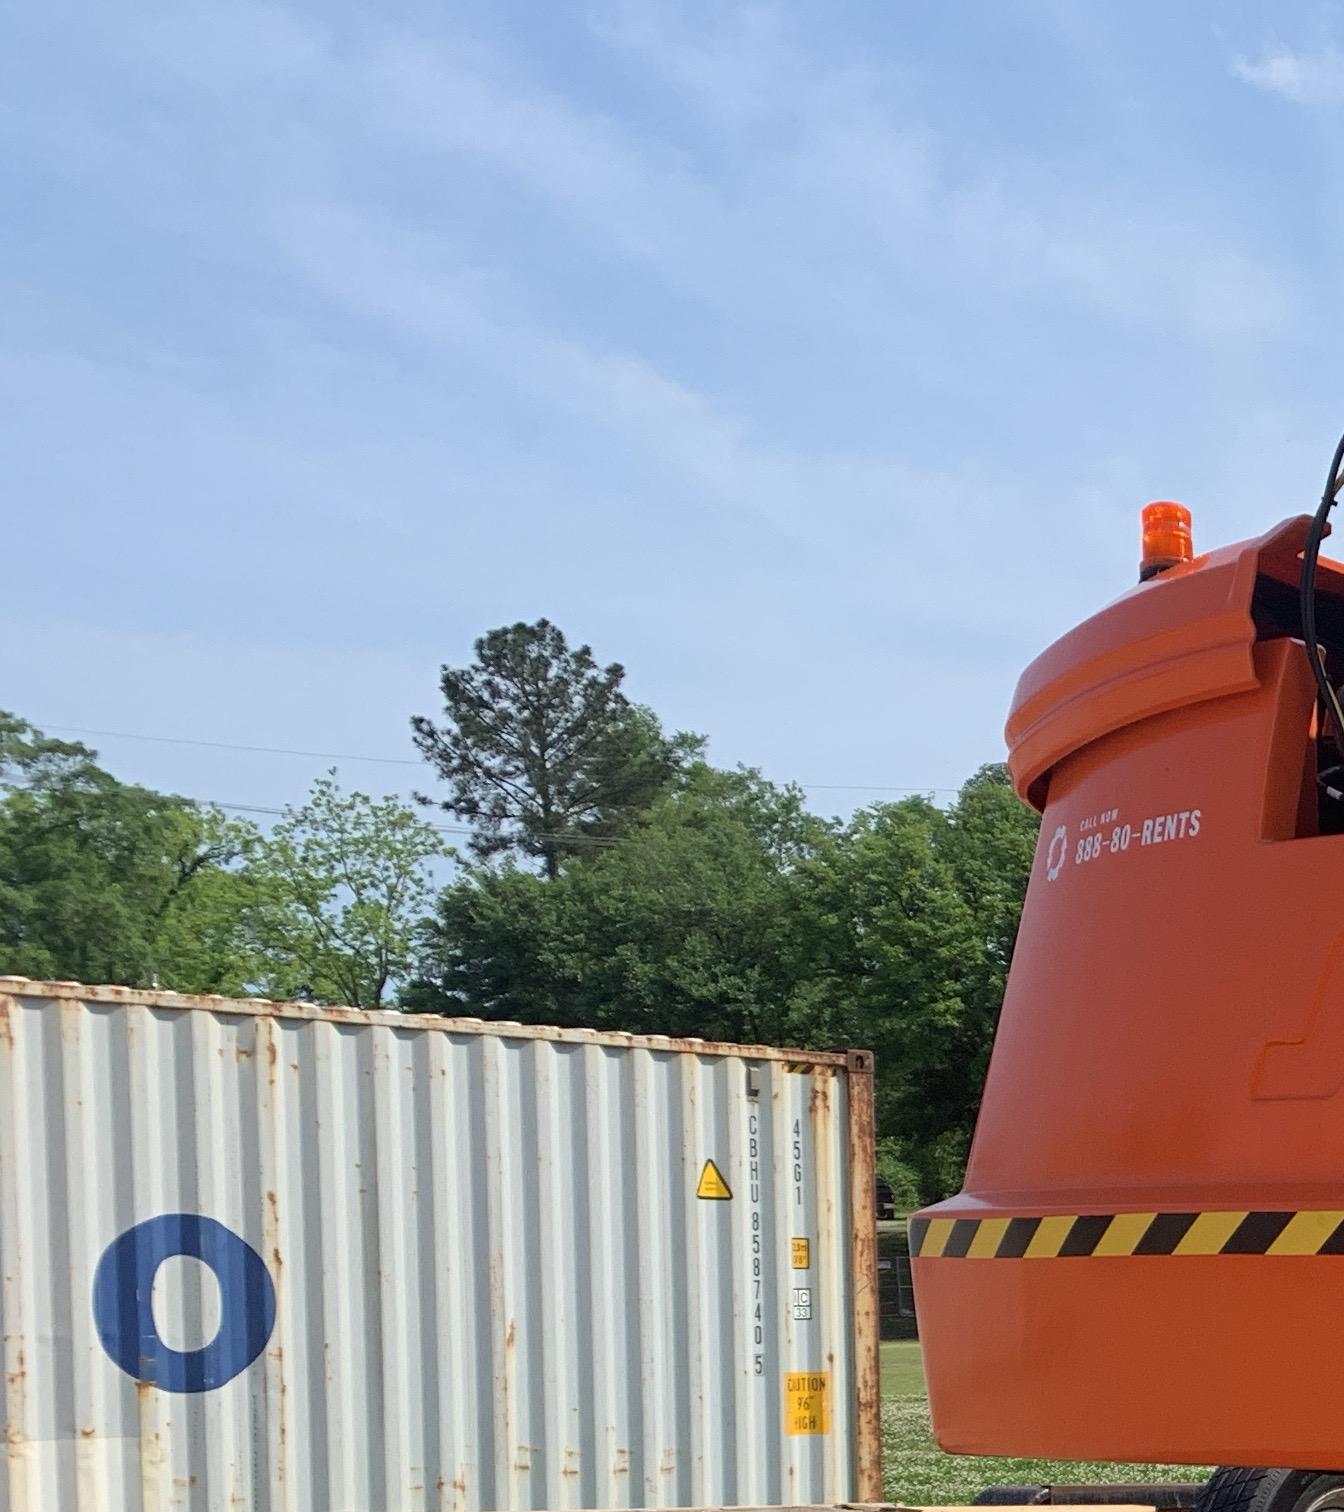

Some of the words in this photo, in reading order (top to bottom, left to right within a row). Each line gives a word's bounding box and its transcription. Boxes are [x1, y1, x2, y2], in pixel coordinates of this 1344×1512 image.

[1075, 809, 1201, 865] 888-80-RENTS
[1080, 814, 1097, 833] CALL
[1100, 808, 1120, 824] NOW
[749, 1115, 760, 1203] CBHU
[793, 1118, 802, 1205] 45G1
